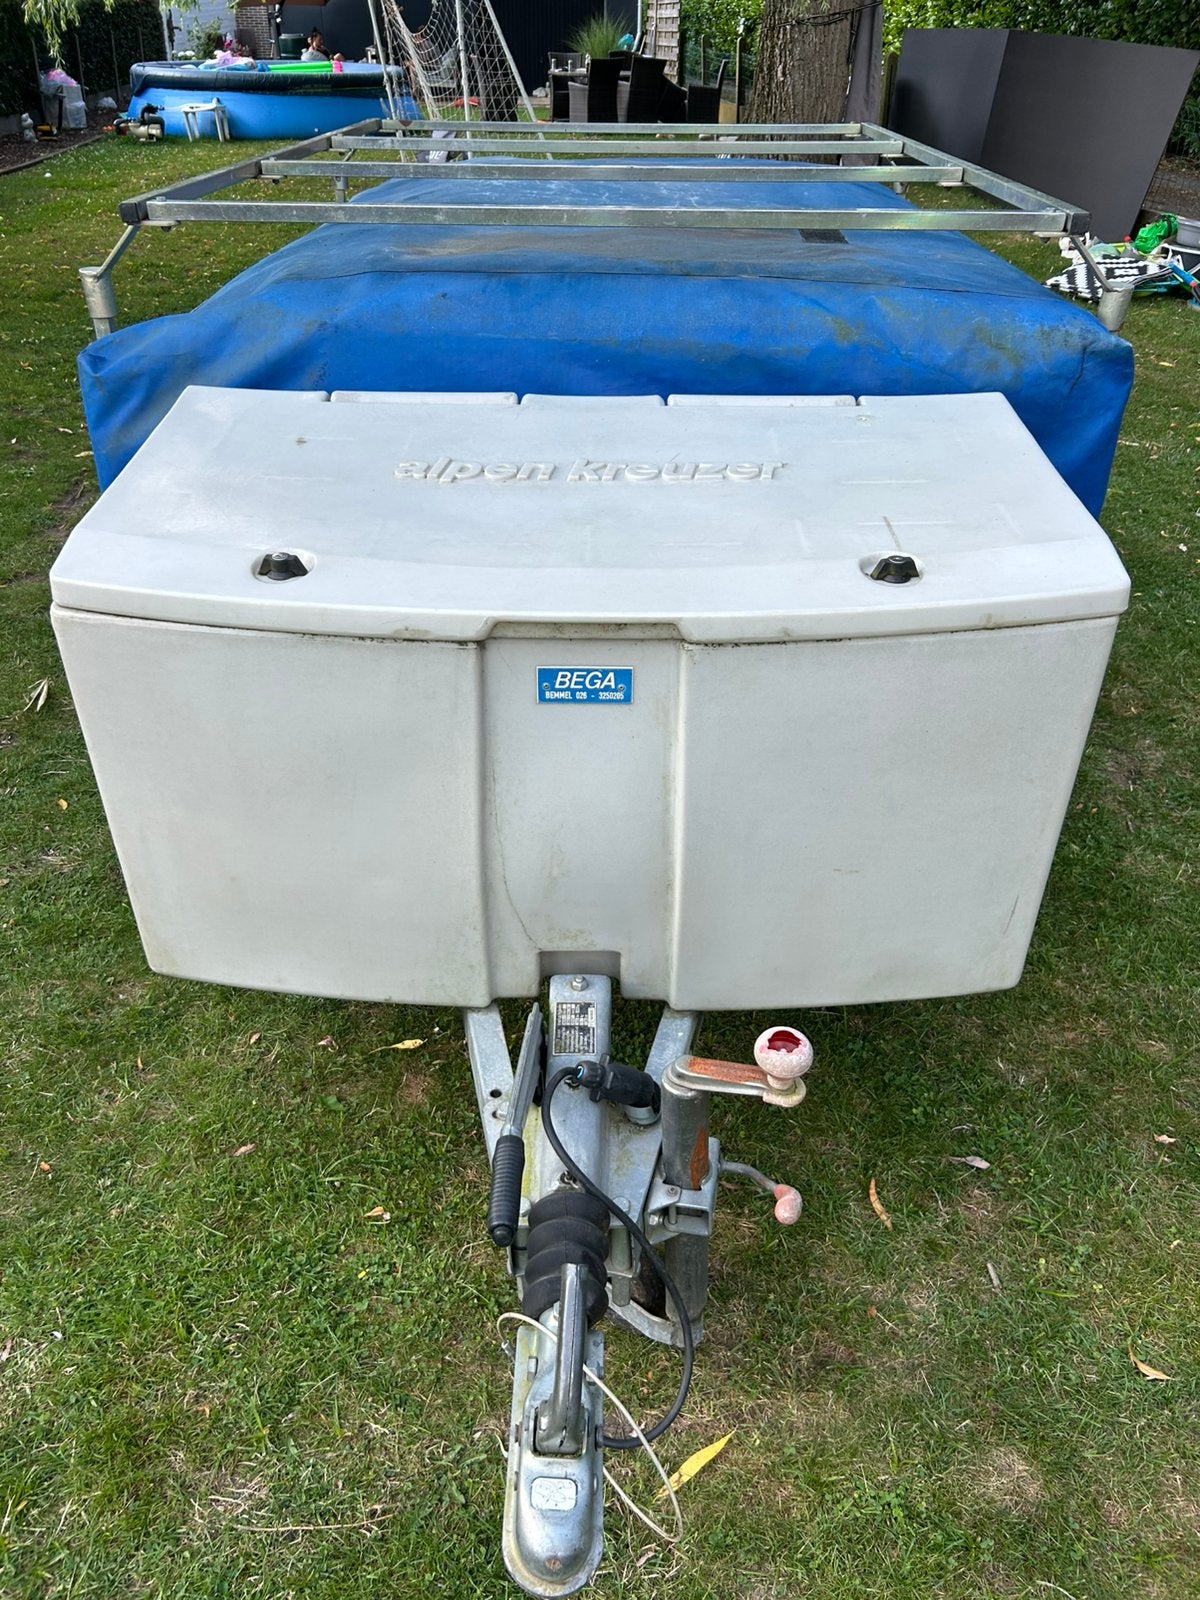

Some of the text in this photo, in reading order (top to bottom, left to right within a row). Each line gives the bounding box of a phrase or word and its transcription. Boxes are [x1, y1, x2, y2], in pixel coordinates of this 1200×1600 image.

[394, 457, 787, 484] alpen kreuzer
[554, 671, 616, 689] BEGA
[545, 691, 573, 700] BEMMEL
